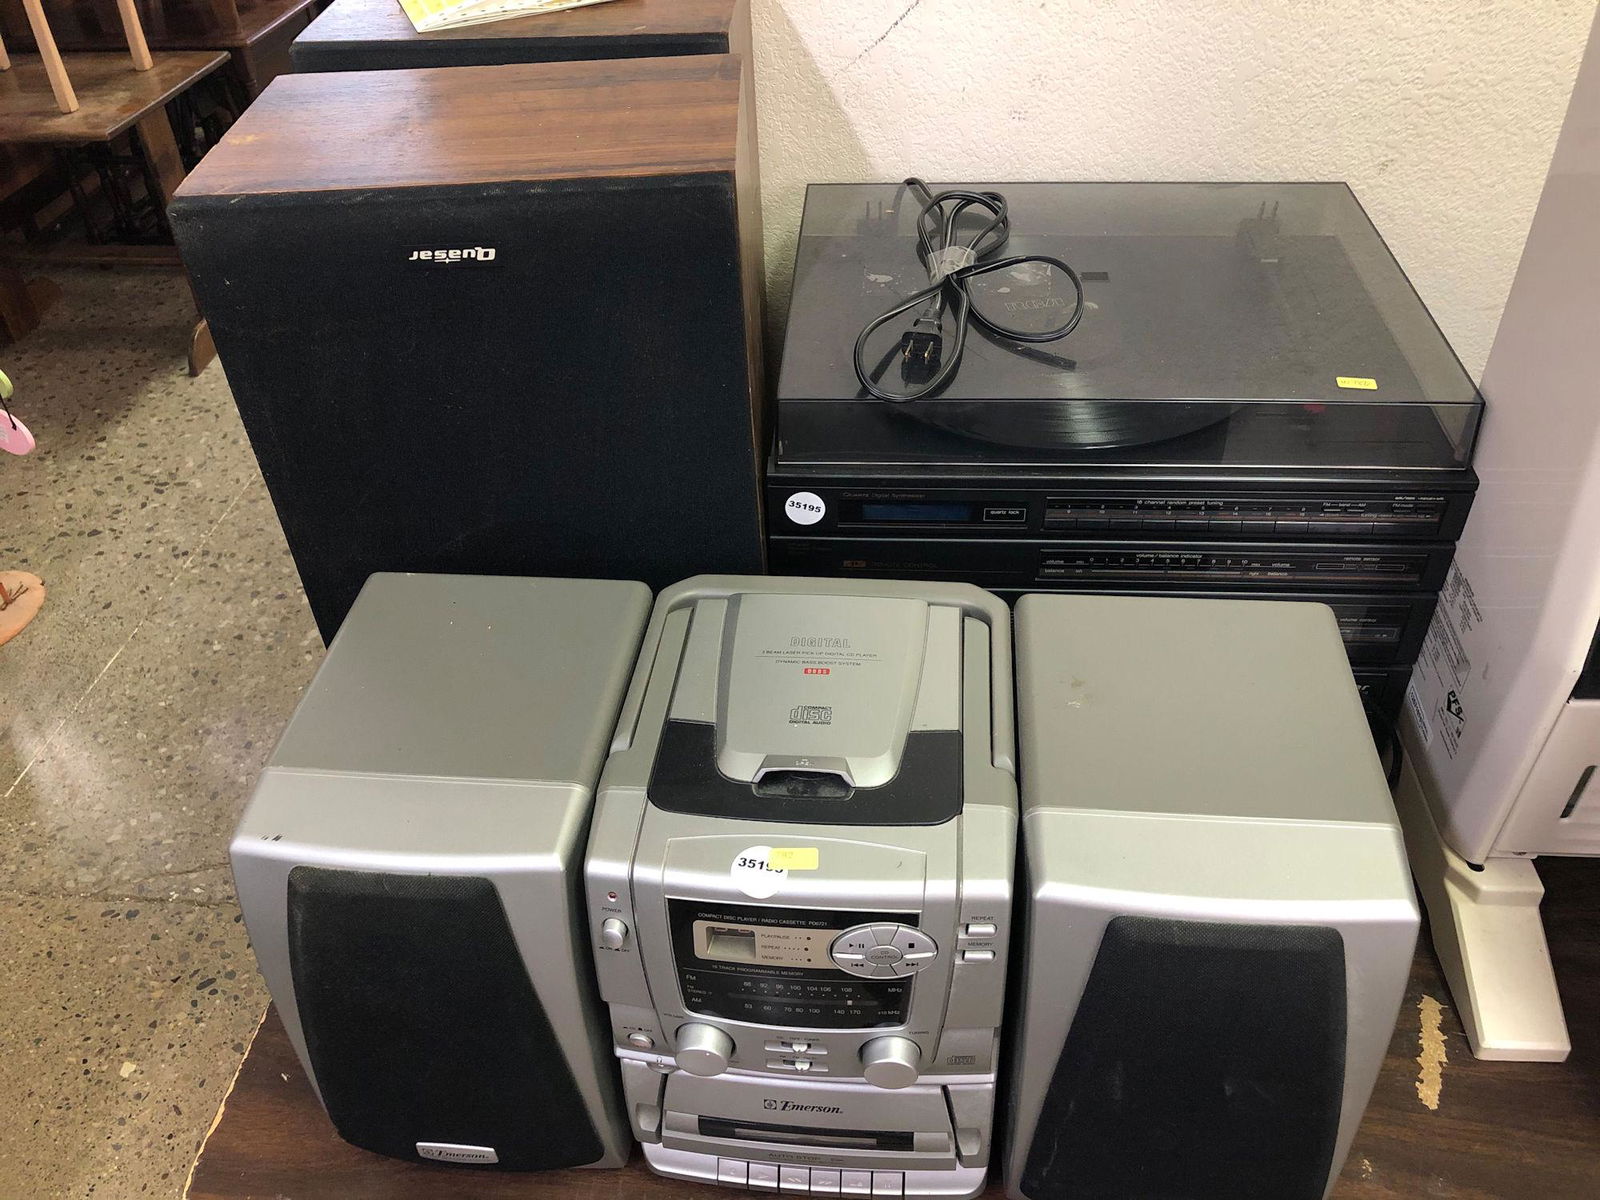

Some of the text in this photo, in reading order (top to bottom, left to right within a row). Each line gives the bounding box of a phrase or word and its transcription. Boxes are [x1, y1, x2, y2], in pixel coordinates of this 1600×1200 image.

[408, 246, 496, 264] Quasar
[788, 500, 822, 513] 35195
[790, 637, 852, 648] DIGITAL
[1448, 690, 1464, 716] PFS
[789, 705, 833, 721] disc
